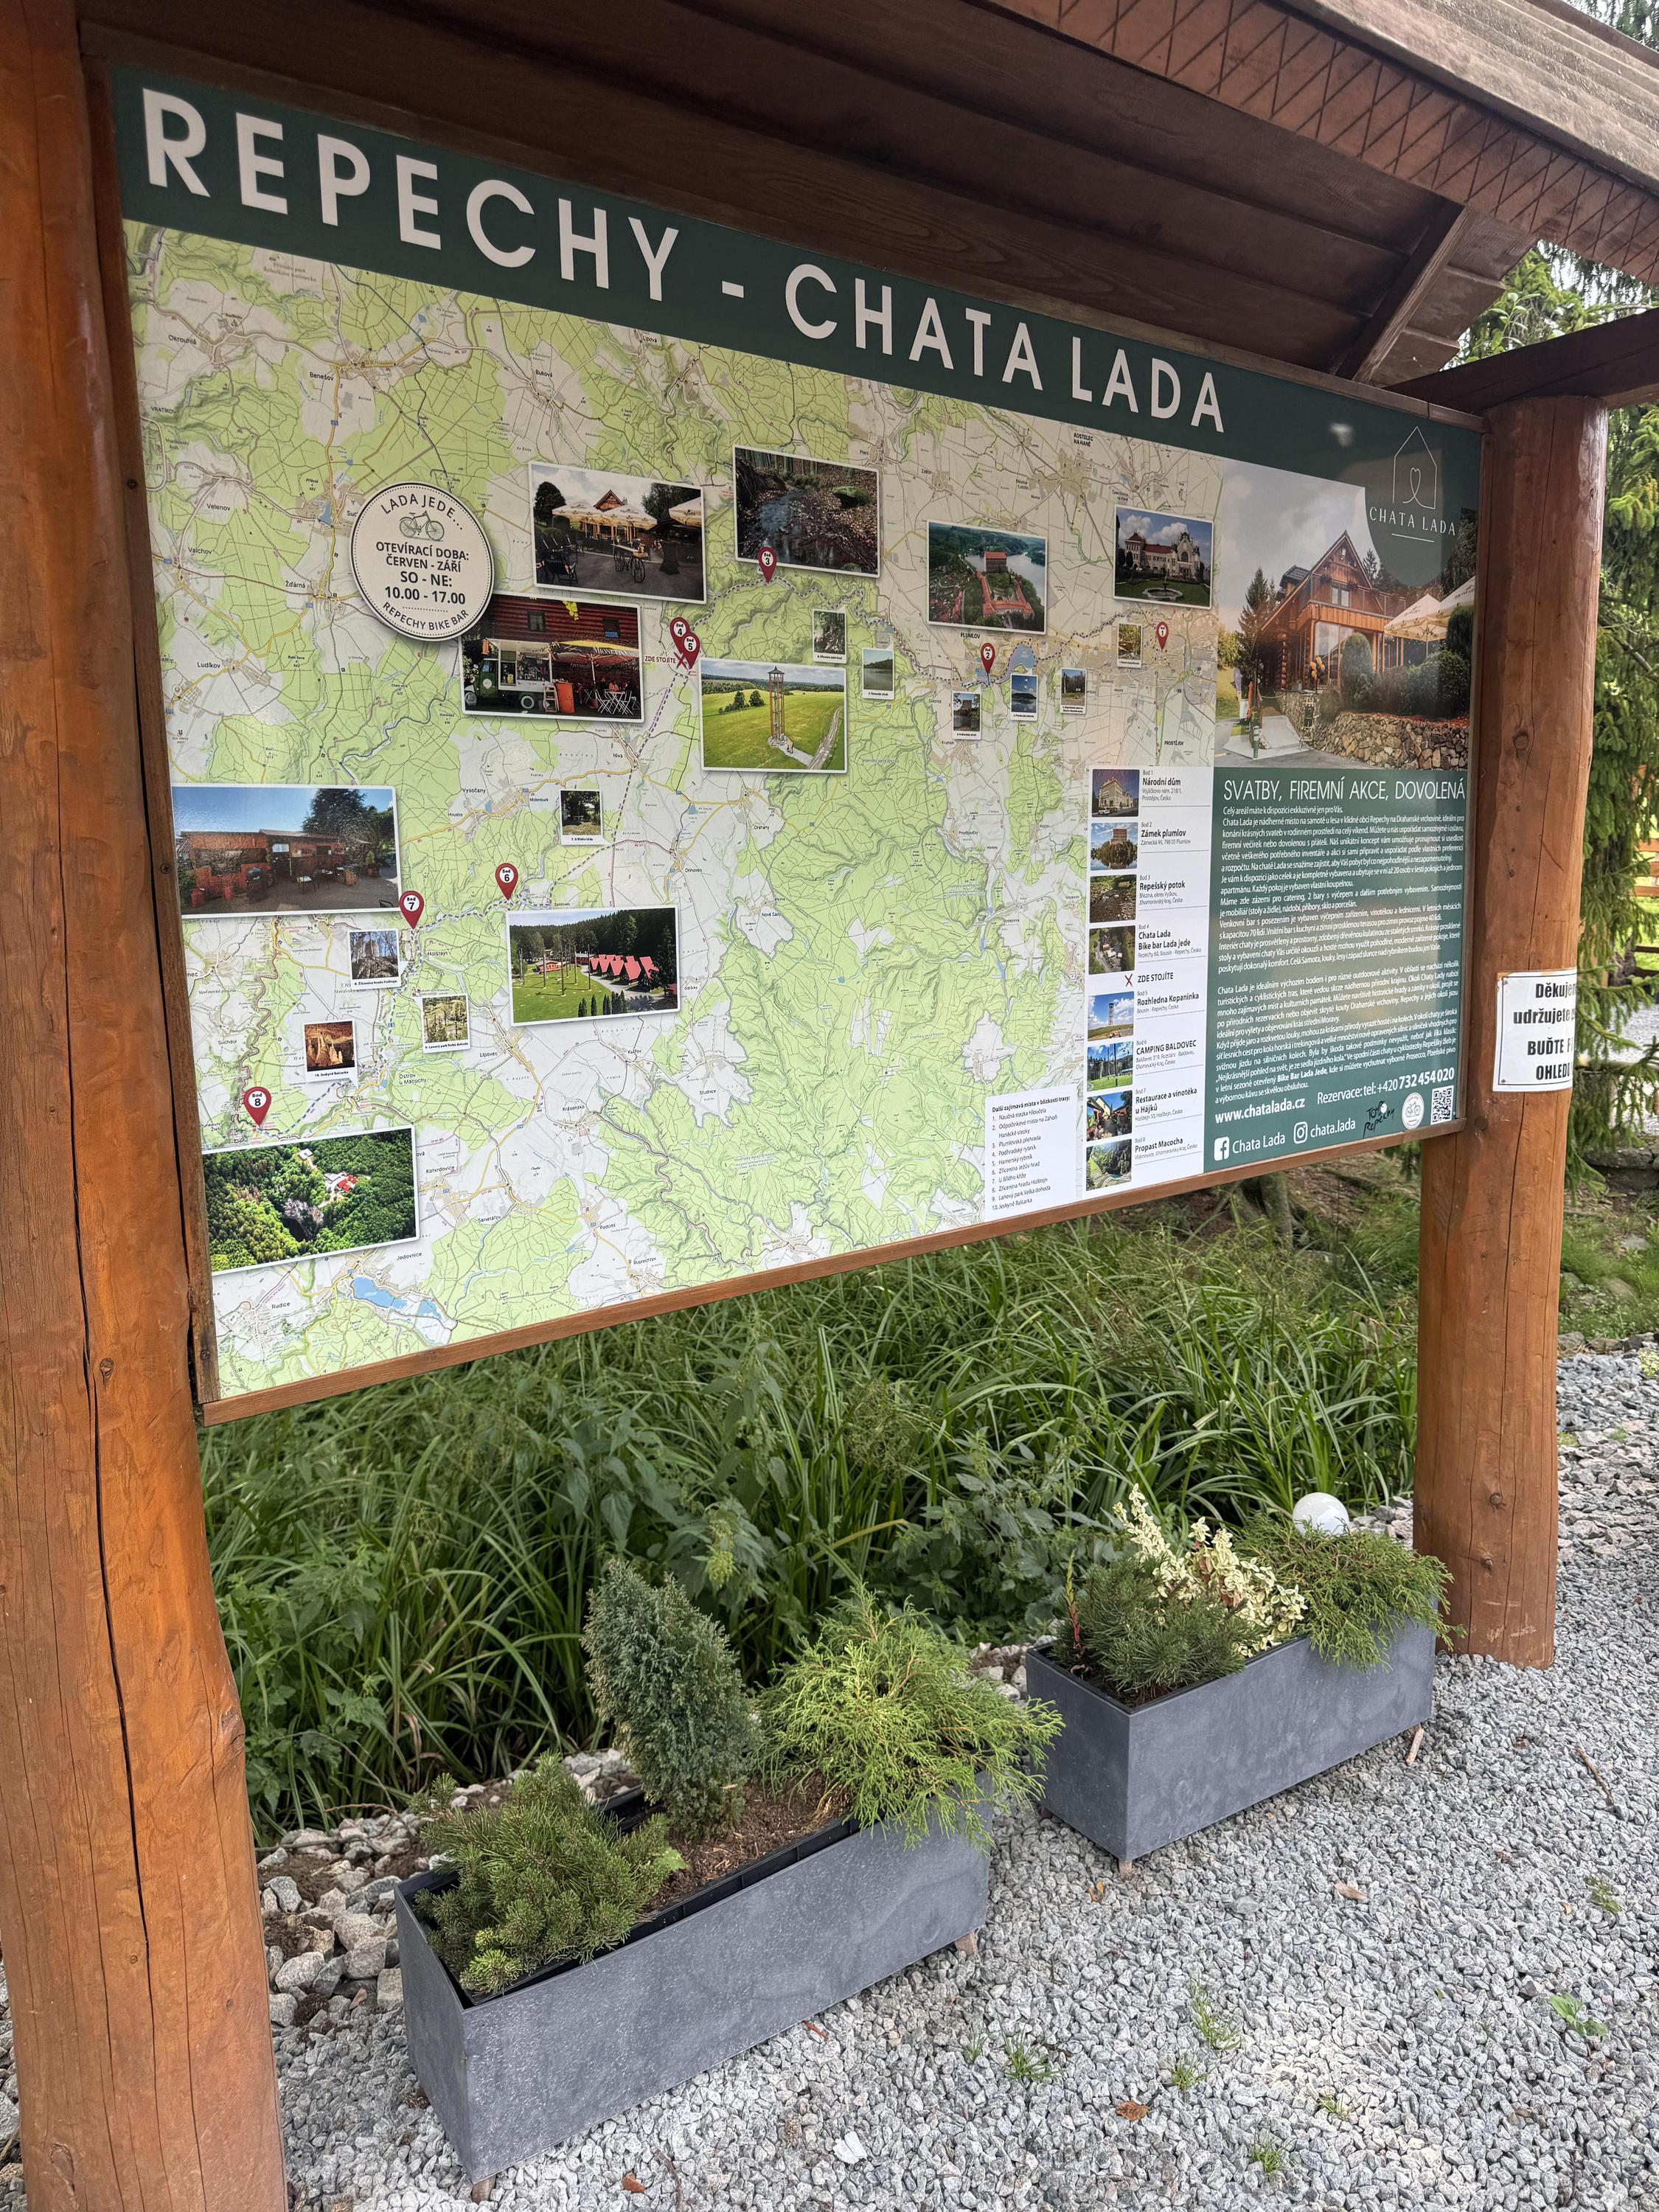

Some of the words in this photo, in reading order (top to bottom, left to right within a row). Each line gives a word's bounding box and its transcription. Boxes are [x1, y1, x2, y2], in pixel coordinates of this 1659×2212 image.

[142, 88, 680, 302] REPECHY
[721, 280, 745, 299] -
[785, 263, 1043, 392] CHATA
[1071, 336, 1225, 434] LADA
[168, 335, 197, 345] Okrouhlá
[310, 372, 334, 381] Benešov
[535, 369, 553, 378] Buková
[206, 503, 230, 511] Velenov
[380, 493, 419, 514] LADA
[1369, 507, 1415, 529] CHATA
[1422, 516, 1455, 536] LADA
[188, 546, 212, 554] Valchov
[376, 541, 433, 557] OTEVÍRACÍ
[437, 548, 470, 561] DOBA:
[386, 553, 428, 569] ČERVEN
[437, 560, 462, 572] ZÁŘÍ
[765, 557, 770, 566] 3
[400, 571, 419, 583] SO
[431, 574, 453, 588] NE:
[385, 586, 420, 600] 10.00
[432, 591, 466, 605] 17.00
[383, 602, 426, 630] REPECHY
[429, 621, 449, 630] BIKE
[451, 609, 470, 624] BAR
[688, 642, 693, 650] 5
[1223, 779, 1282, 801] SVATBY,
[1290, 776, 1346, 800] FIREMNÍ
[1349, 780, 1388, 801] AKCE,
[1395, 778, 1465, 800] DOVOLENÁ
[1223, 807, 1235, 816] Celý
[1236, 807, 1248, 815] areál
[1249, 807, 1262, 815] máte
[1267, 806, 1290, 815] dispozici
[1222, 818, 1239, 826] Chata
[1240, 818, 1252, 826] Lada
[1253, 818, 1258, 827] je
[1259, 818, 1284, 826] nádherné
[1284, 816, 1299, 826] místo
[1307, 816, 1325, 825] samotě
[1370, 815, 1389, 825] Repechy
[1141, 830, 1161, 838] Zámek
[1163, 829, 1186, 839] plumlov
[504, 874, 509, 882] 6
[1140, 882, 1167, 891] Repešský
[1168, 880, 1186, 890] potok
[408, 902, 414, 910] 7
[1138, 931, 1155, 939] Chata
[1157, 930, 1171, 939] Lada
[1138, 942, 1151, 950] Bike
[1152, 941, 1162, 949] bar
[1164, 939, 1177, 948] Lada
[1178, 939, 1191, 948] jede
[1138, 974, 1150, 983] ZDE
[1150, 972, 1174, 982] STOJÍTE
[1217, 987, 1234, 995] Chata
[1235, 985, 1248, 993] Lada
[1137, 996, 1168, 1006] Rozhledna
[1169, 992, 1200, 1004] Kopaninka
[1513, 1008, 1570, 1025] udržujete
[1136, 1043, 1164, 1055] CAMPING
[1166, 1040, 1197, 1051] BALDOVEC
[1528, 1037, 1564, 1055] BUĎTE
[1277, 1074, 1290, 1083] Bike
[1290, 1072, 1300, 1082] Bar
[1301, 1070, 1313, 1079] Lada
[1317, 1088, 1363, 1105] Rezervace:
[1363, 1082, 1377, 1095] tel:
[1377, 1079, 1398, 1093] +420
[1399, 1074, 1417, 1089] 732
[1418, 1070, 1436, 1085] 454
[1437, 1067, 1454, 1082] 020
[254, 1098, 261, 1106] 8
[1135, 1093, 1166, 1105] Restaurace
[1173, 1088, 1197, 1099] vinotéka
[1004, 1103, 1023, 1111] zajímavá
[1040, 1097, 1058, 1105] blízkosti
[1141, 1104, 1157, 1115] Hájků
[1215, 1097, 1305, 1124] www.chatalada.cz
[1310, 1118, 1356, 1138] chata.lada
[1135, 1143, 1157, 1153] Propast
[1158, 1138, 1183, 1148] Macocha
[1232, 1139, 1261, 1154] Chata
[1263, 1132, 1285, 1148] Lada
[426, 1165, 455, 1173] Kotvrdovice
[397, 1252, 422, 1261] Jedovnice
